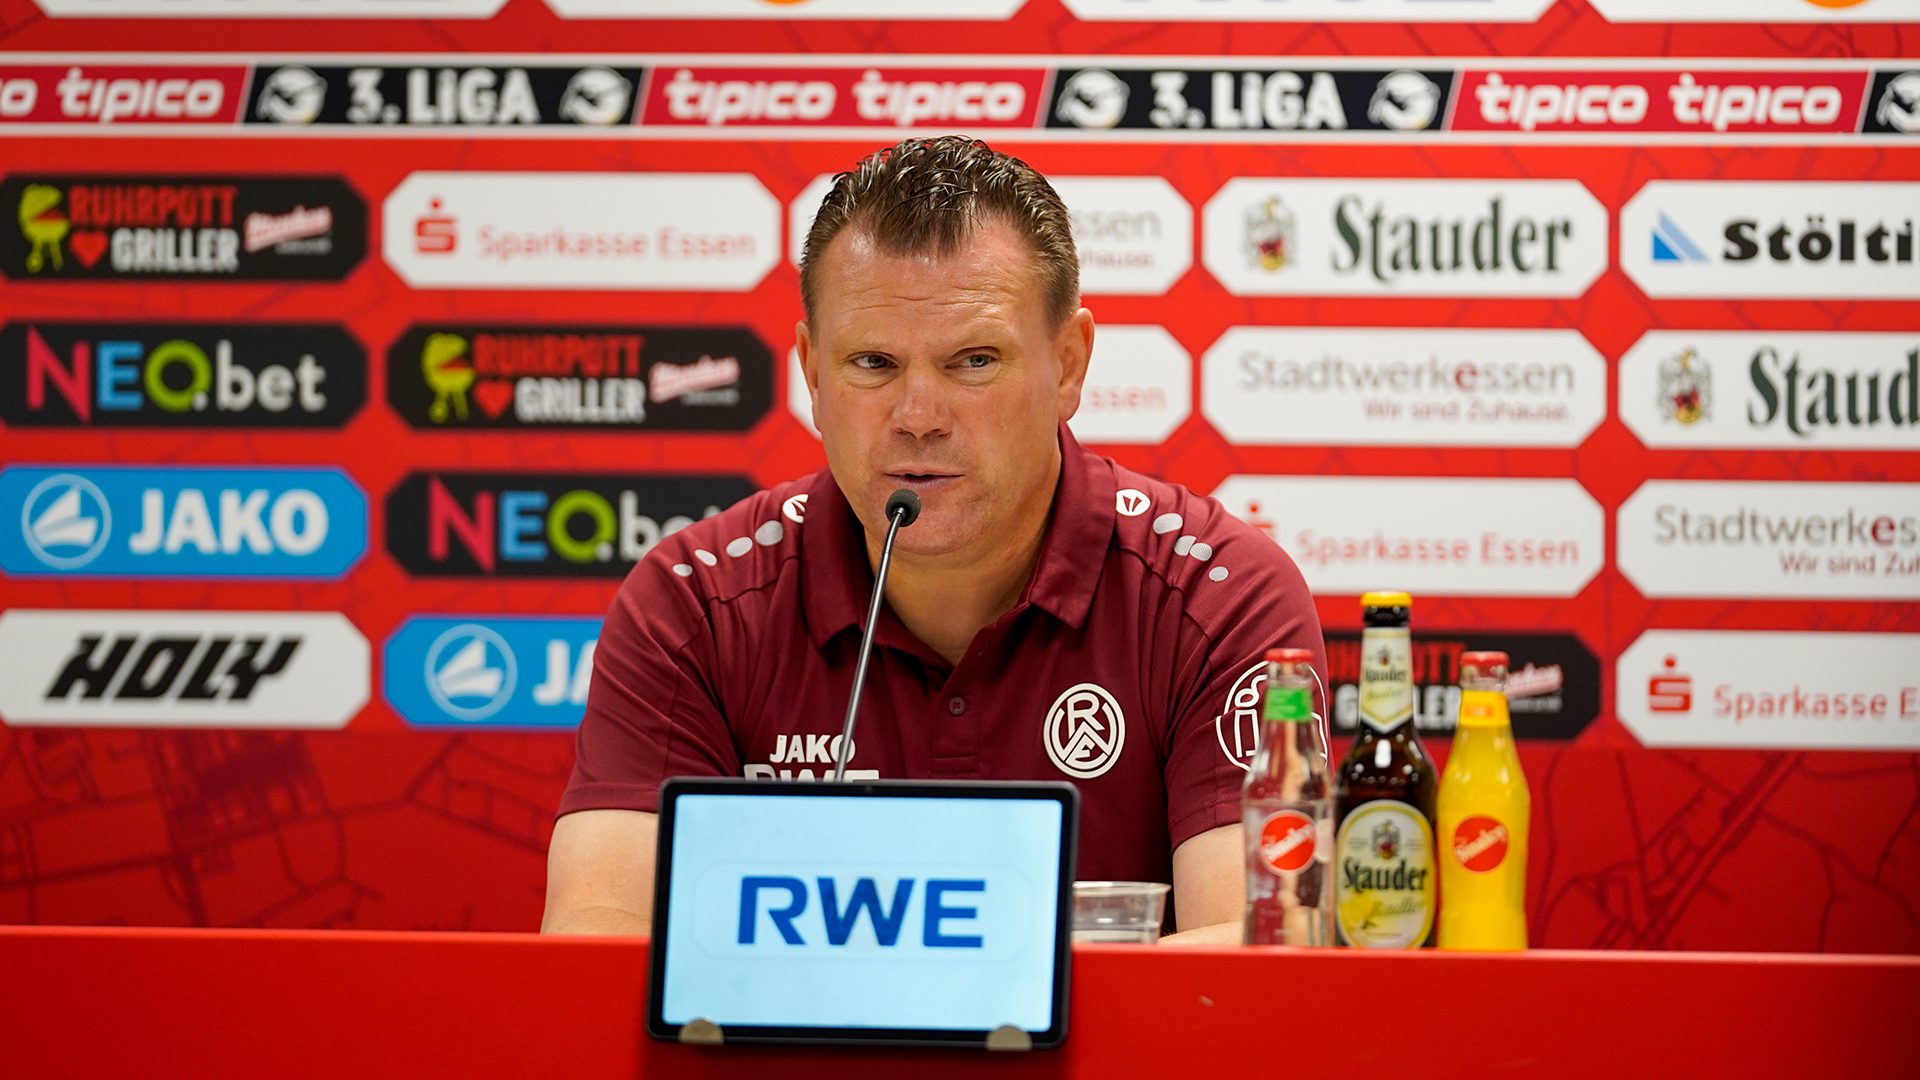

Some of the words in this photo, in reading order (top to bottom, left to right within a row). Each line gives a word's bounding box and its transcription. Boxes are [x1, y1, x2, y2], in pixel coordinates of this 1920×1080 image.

[56, 66, 225, 122] tipico
[347, 67, 401, 124] 3.
[406, 68, 541, 125] LIGA
[664, 69, 836, 125] tipico
[853, 69, 1026, 125] tipico
[1149, 71, 1205, 128] 3.
[1211, 71, 1345, 128] LIGA
[1475, 73, 1649, 131] tipico
[1668, 73, 1843, 131] tipico
[69, 185, 237, 227] RUHRPOTT
[111, 227, 239, 273] GRILLER
[477, 225, 649, 264] Sparkasse
[658, 228, 757, 259] Essen
[1332, 196, 1572, 280] Stauder
[1722, 215, 1914, 262] Stölti
[473, 336, 644, 376] RUHRPOTT
[1239, 350, 1576, 392] Stadtwerkessen
[515, 377, 646, 423] GRILLER
[129, 488, 329, 556] JAKO
[1296, 530, 1470, 569] Sparkasse
[1480, 534, 1579, 566] Essen
[1780, 552, 1818, 574] Wir
[1828, 552, 1876, 575] sind
[44, 632, 304, 700] HOLY
[1714, 683, 1888, 722] Sparkasse
[769, 734, 856, 763] JAKO
[1343, 856, 1428, 894] Stauder
[736, 876, 986, 949] RWE
